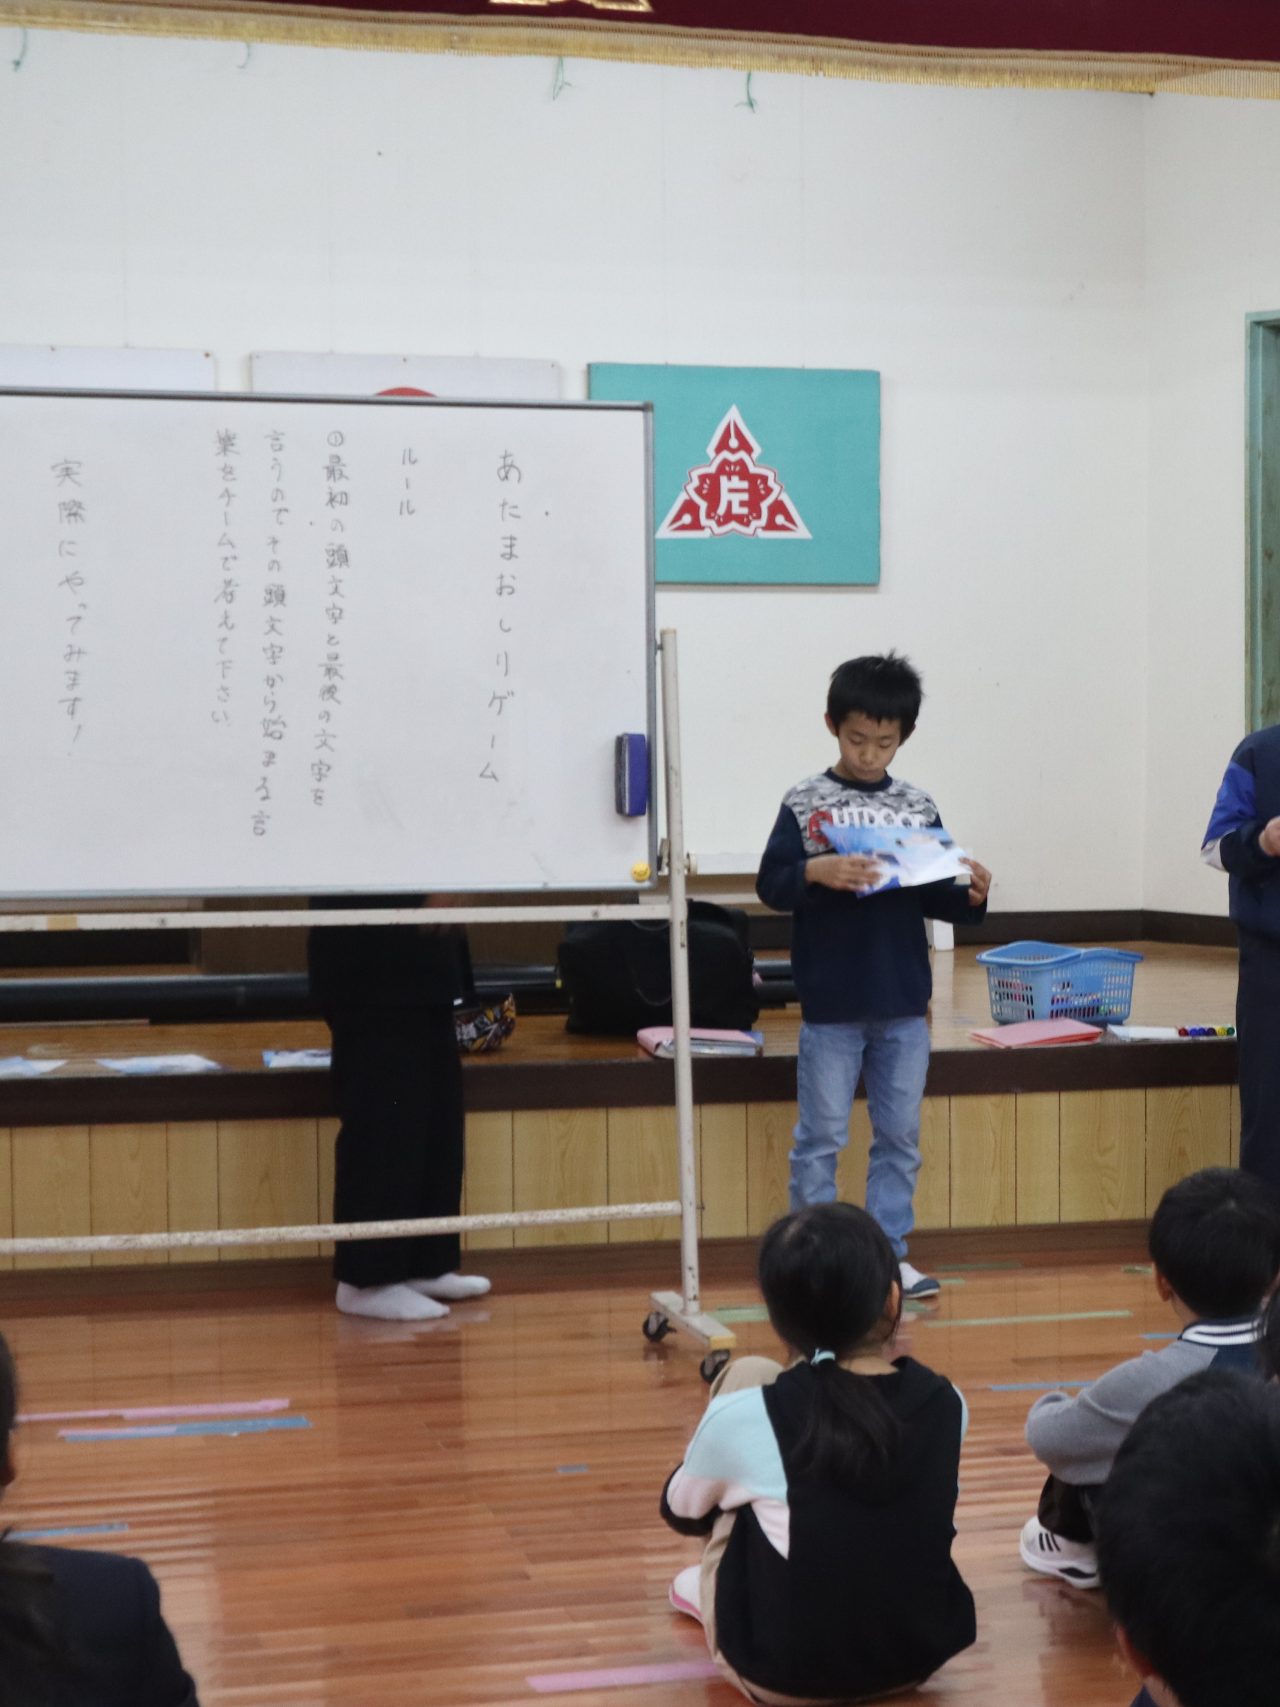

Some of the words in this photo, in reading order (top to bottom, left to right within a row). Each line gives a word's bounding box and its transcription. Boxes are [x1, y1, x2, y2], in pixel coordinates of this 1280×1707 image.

[399, 448, 418, 516] ルール
[479, 449, 522, 782] あたまおしりゲーム
